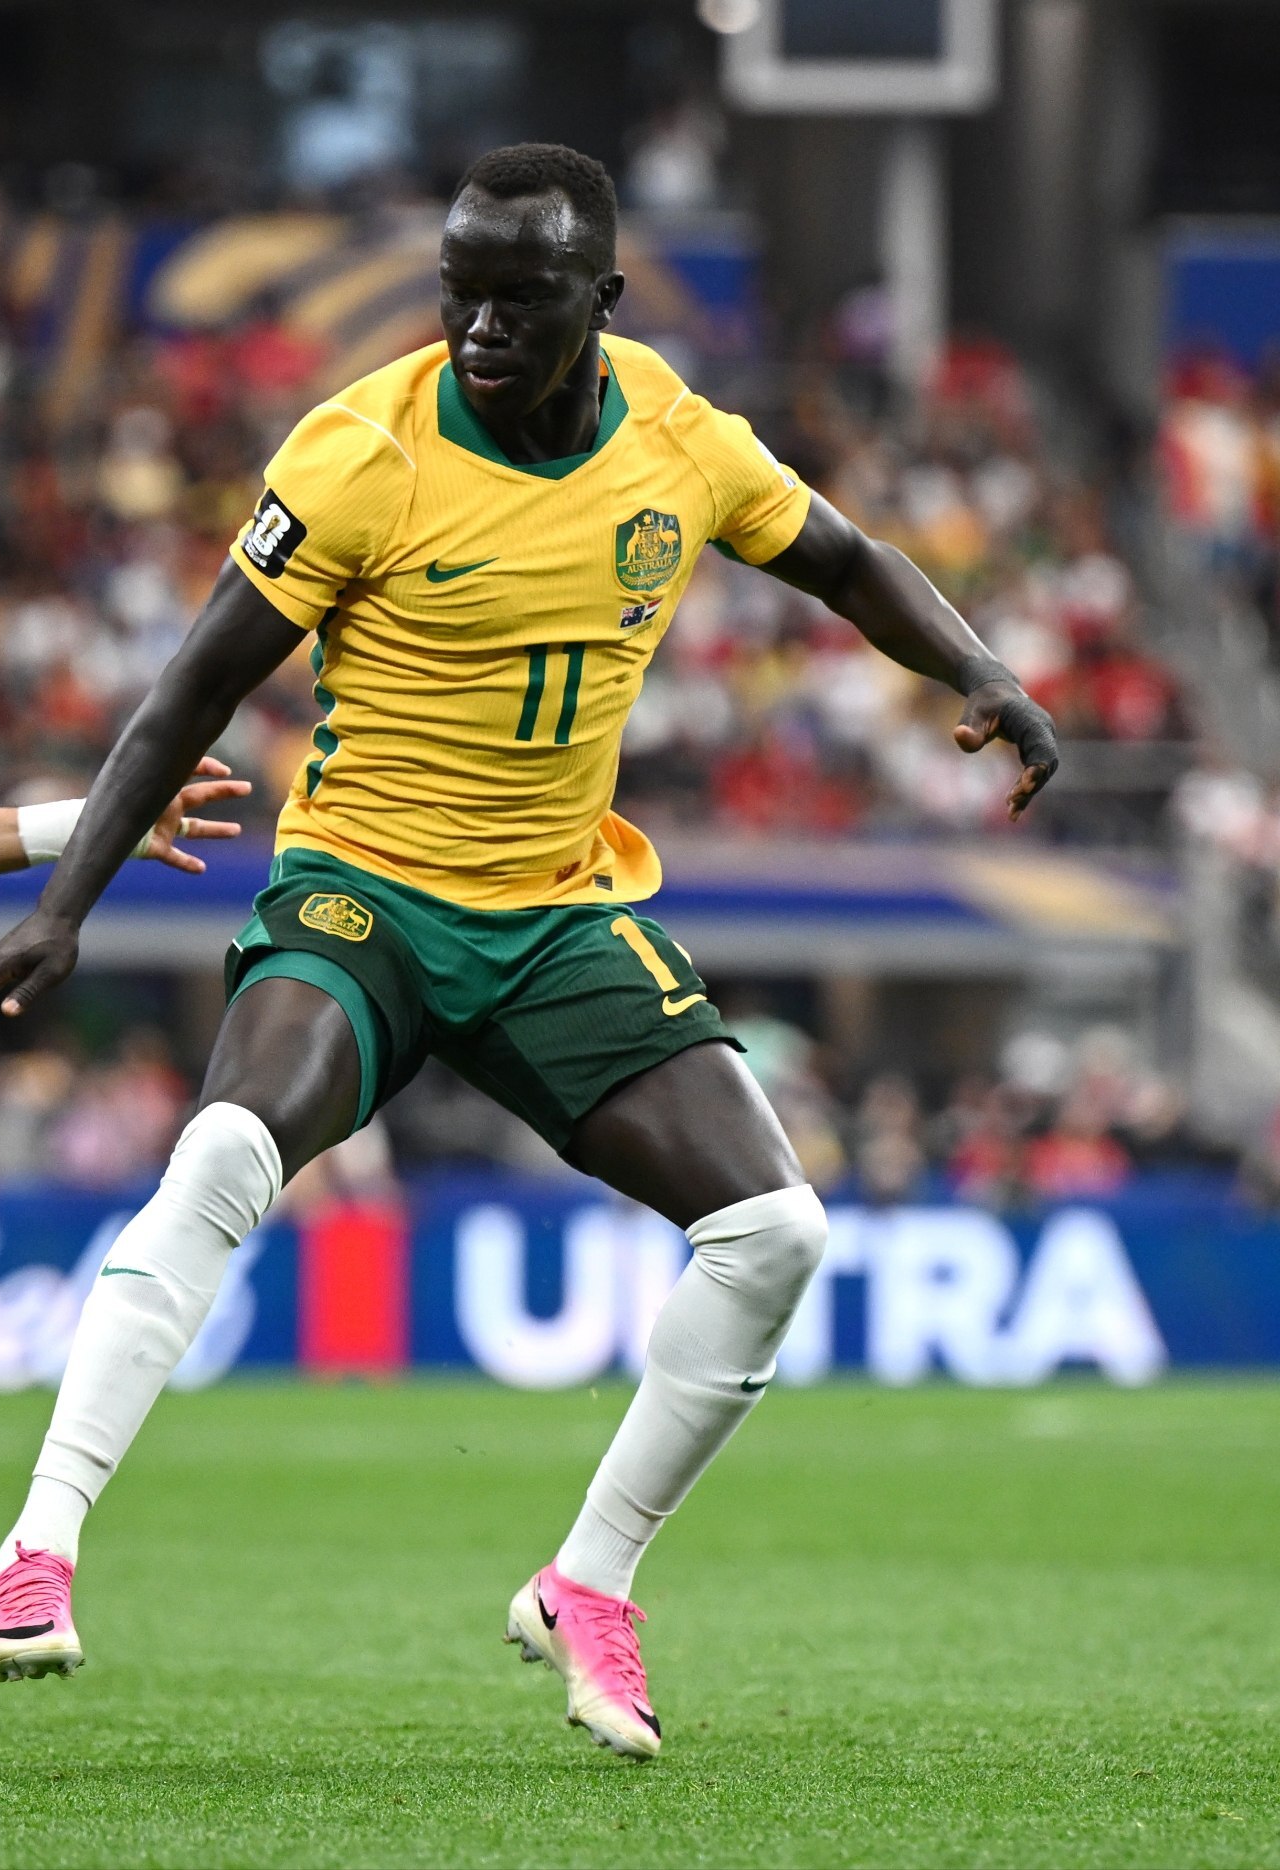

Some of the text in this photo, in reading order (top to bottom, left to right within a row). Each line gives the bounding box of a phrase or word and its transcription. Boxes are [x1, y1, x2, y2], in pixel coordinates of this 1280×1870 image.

[627, 558, 673, 574] AUSTRALIA
[514, 641, 586, 745] 11
[610, 915, 703, 992] 1
